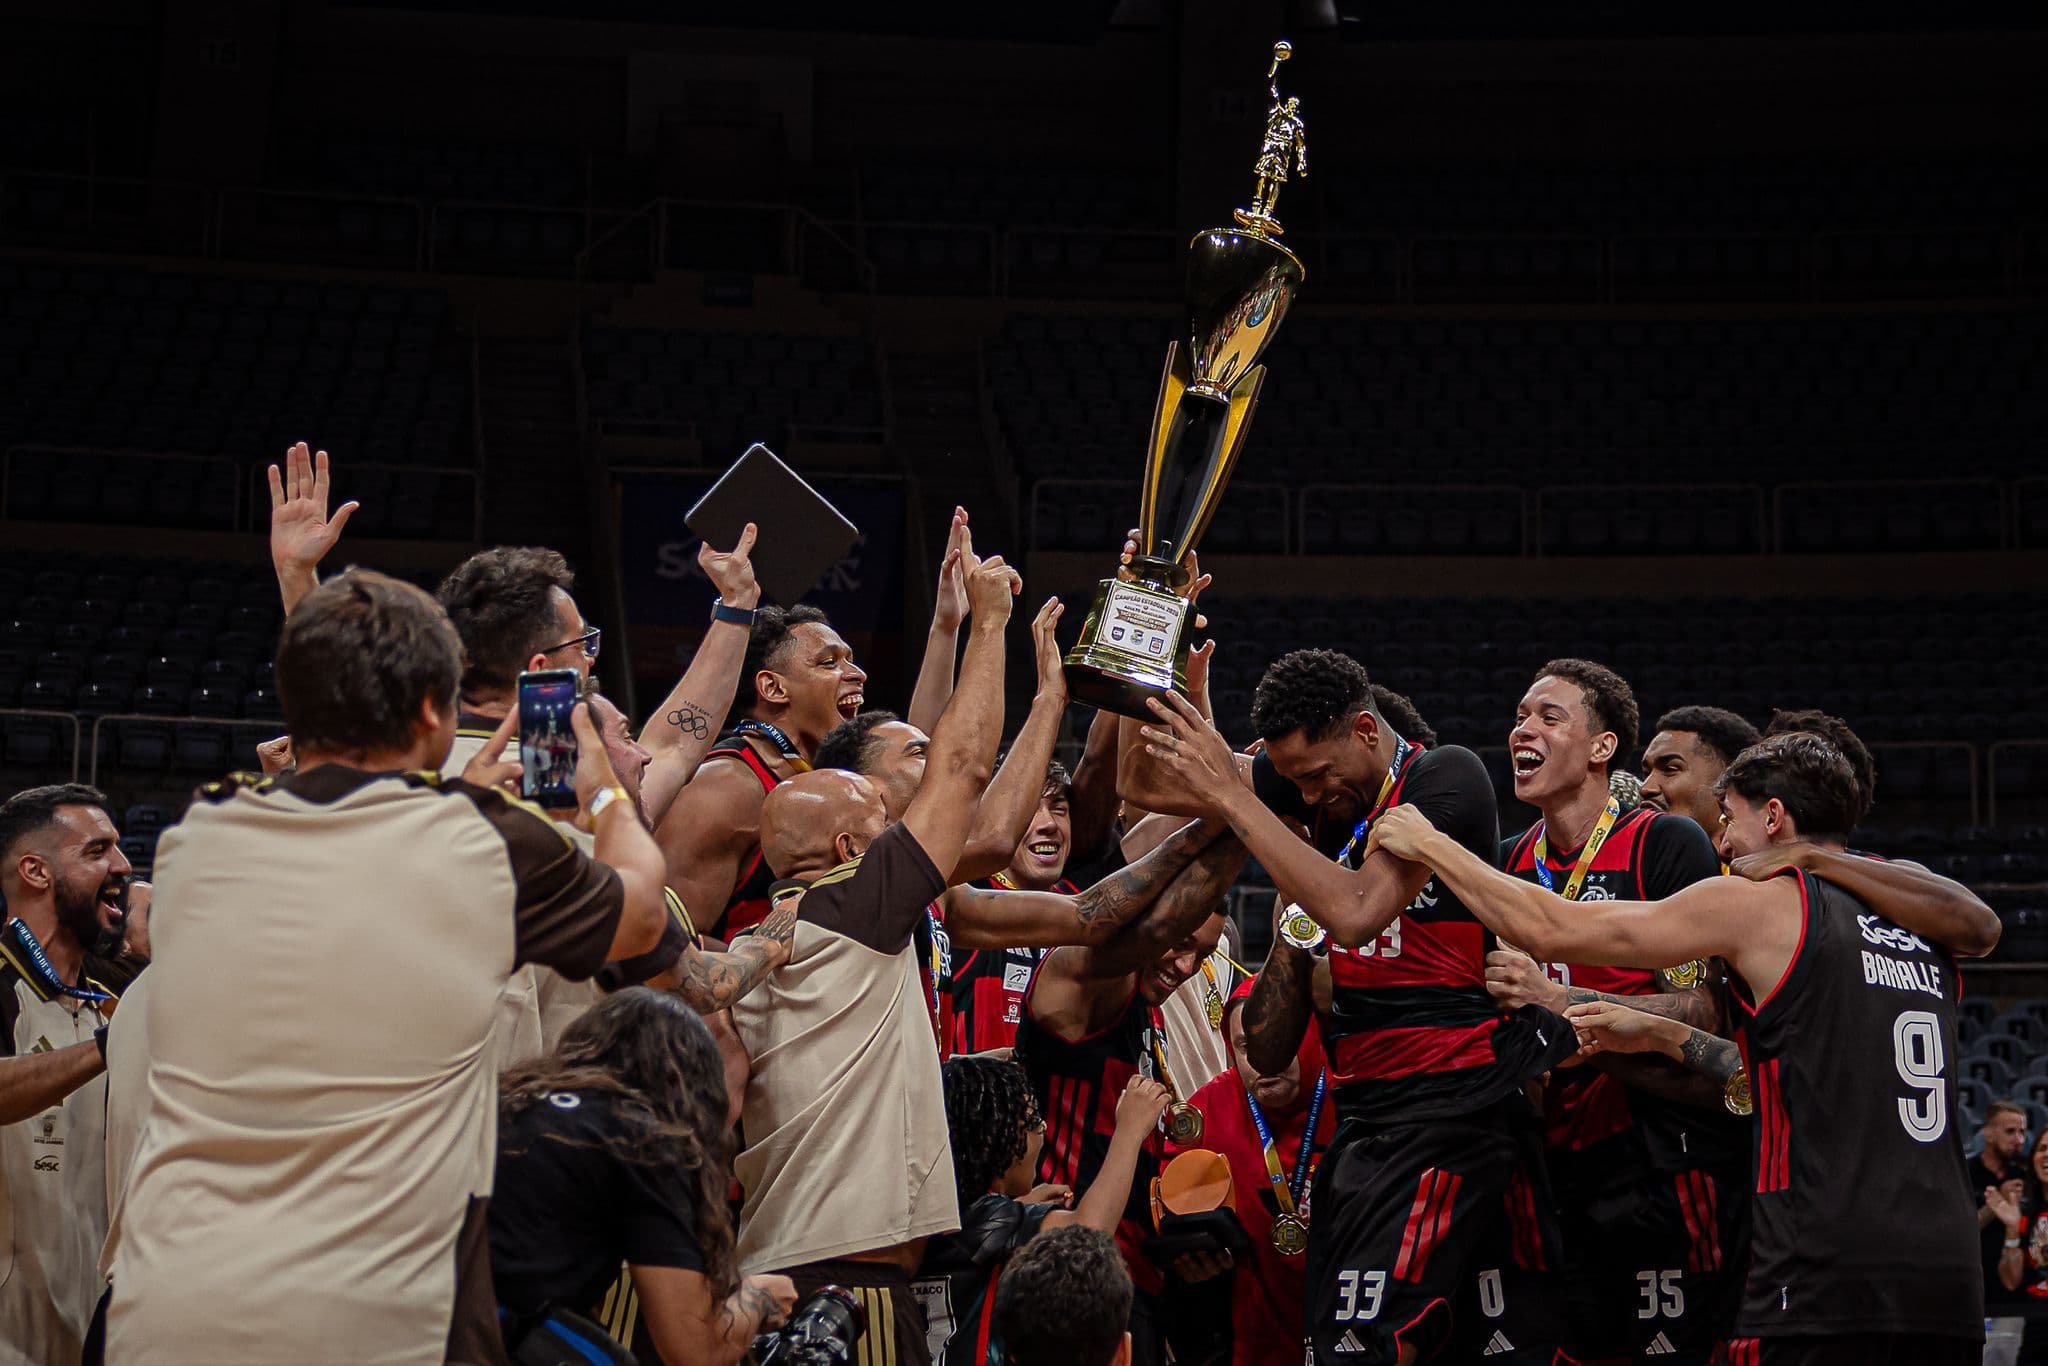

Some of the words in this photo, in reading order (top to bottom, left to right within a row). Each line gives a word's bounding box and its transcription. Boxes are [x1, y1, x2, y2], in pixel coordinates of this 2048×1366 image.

[1861, 950, 1943, 999] BARALLE
[1894, 1010, 1946, 1142] 9
[1335, 1270, 1387, 1320] 33
[1478, 1269, 1504, 1317] 0
[1636, 1269, 1685, 1319] 35
